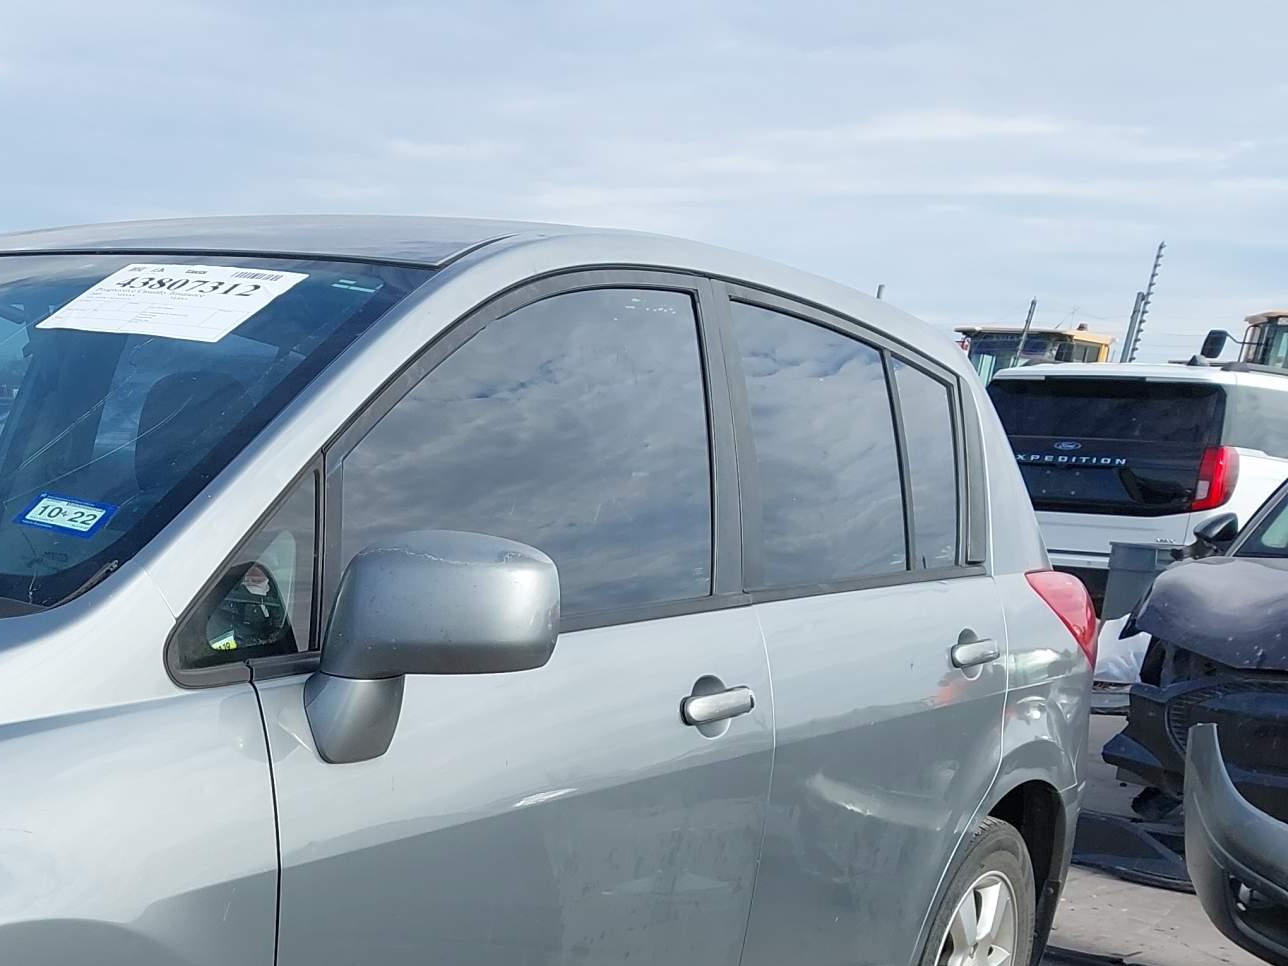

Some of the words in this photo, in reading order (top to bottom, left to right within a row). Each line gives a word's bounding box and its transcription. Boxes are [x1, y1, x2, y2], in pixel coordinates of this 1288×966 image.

[116, 277, 261, 296] 43807312
[1016, 454, 1127, 465] XPEDITION
[38, 504, 63, 518] 10
[67, 511, 98, 525] 22
